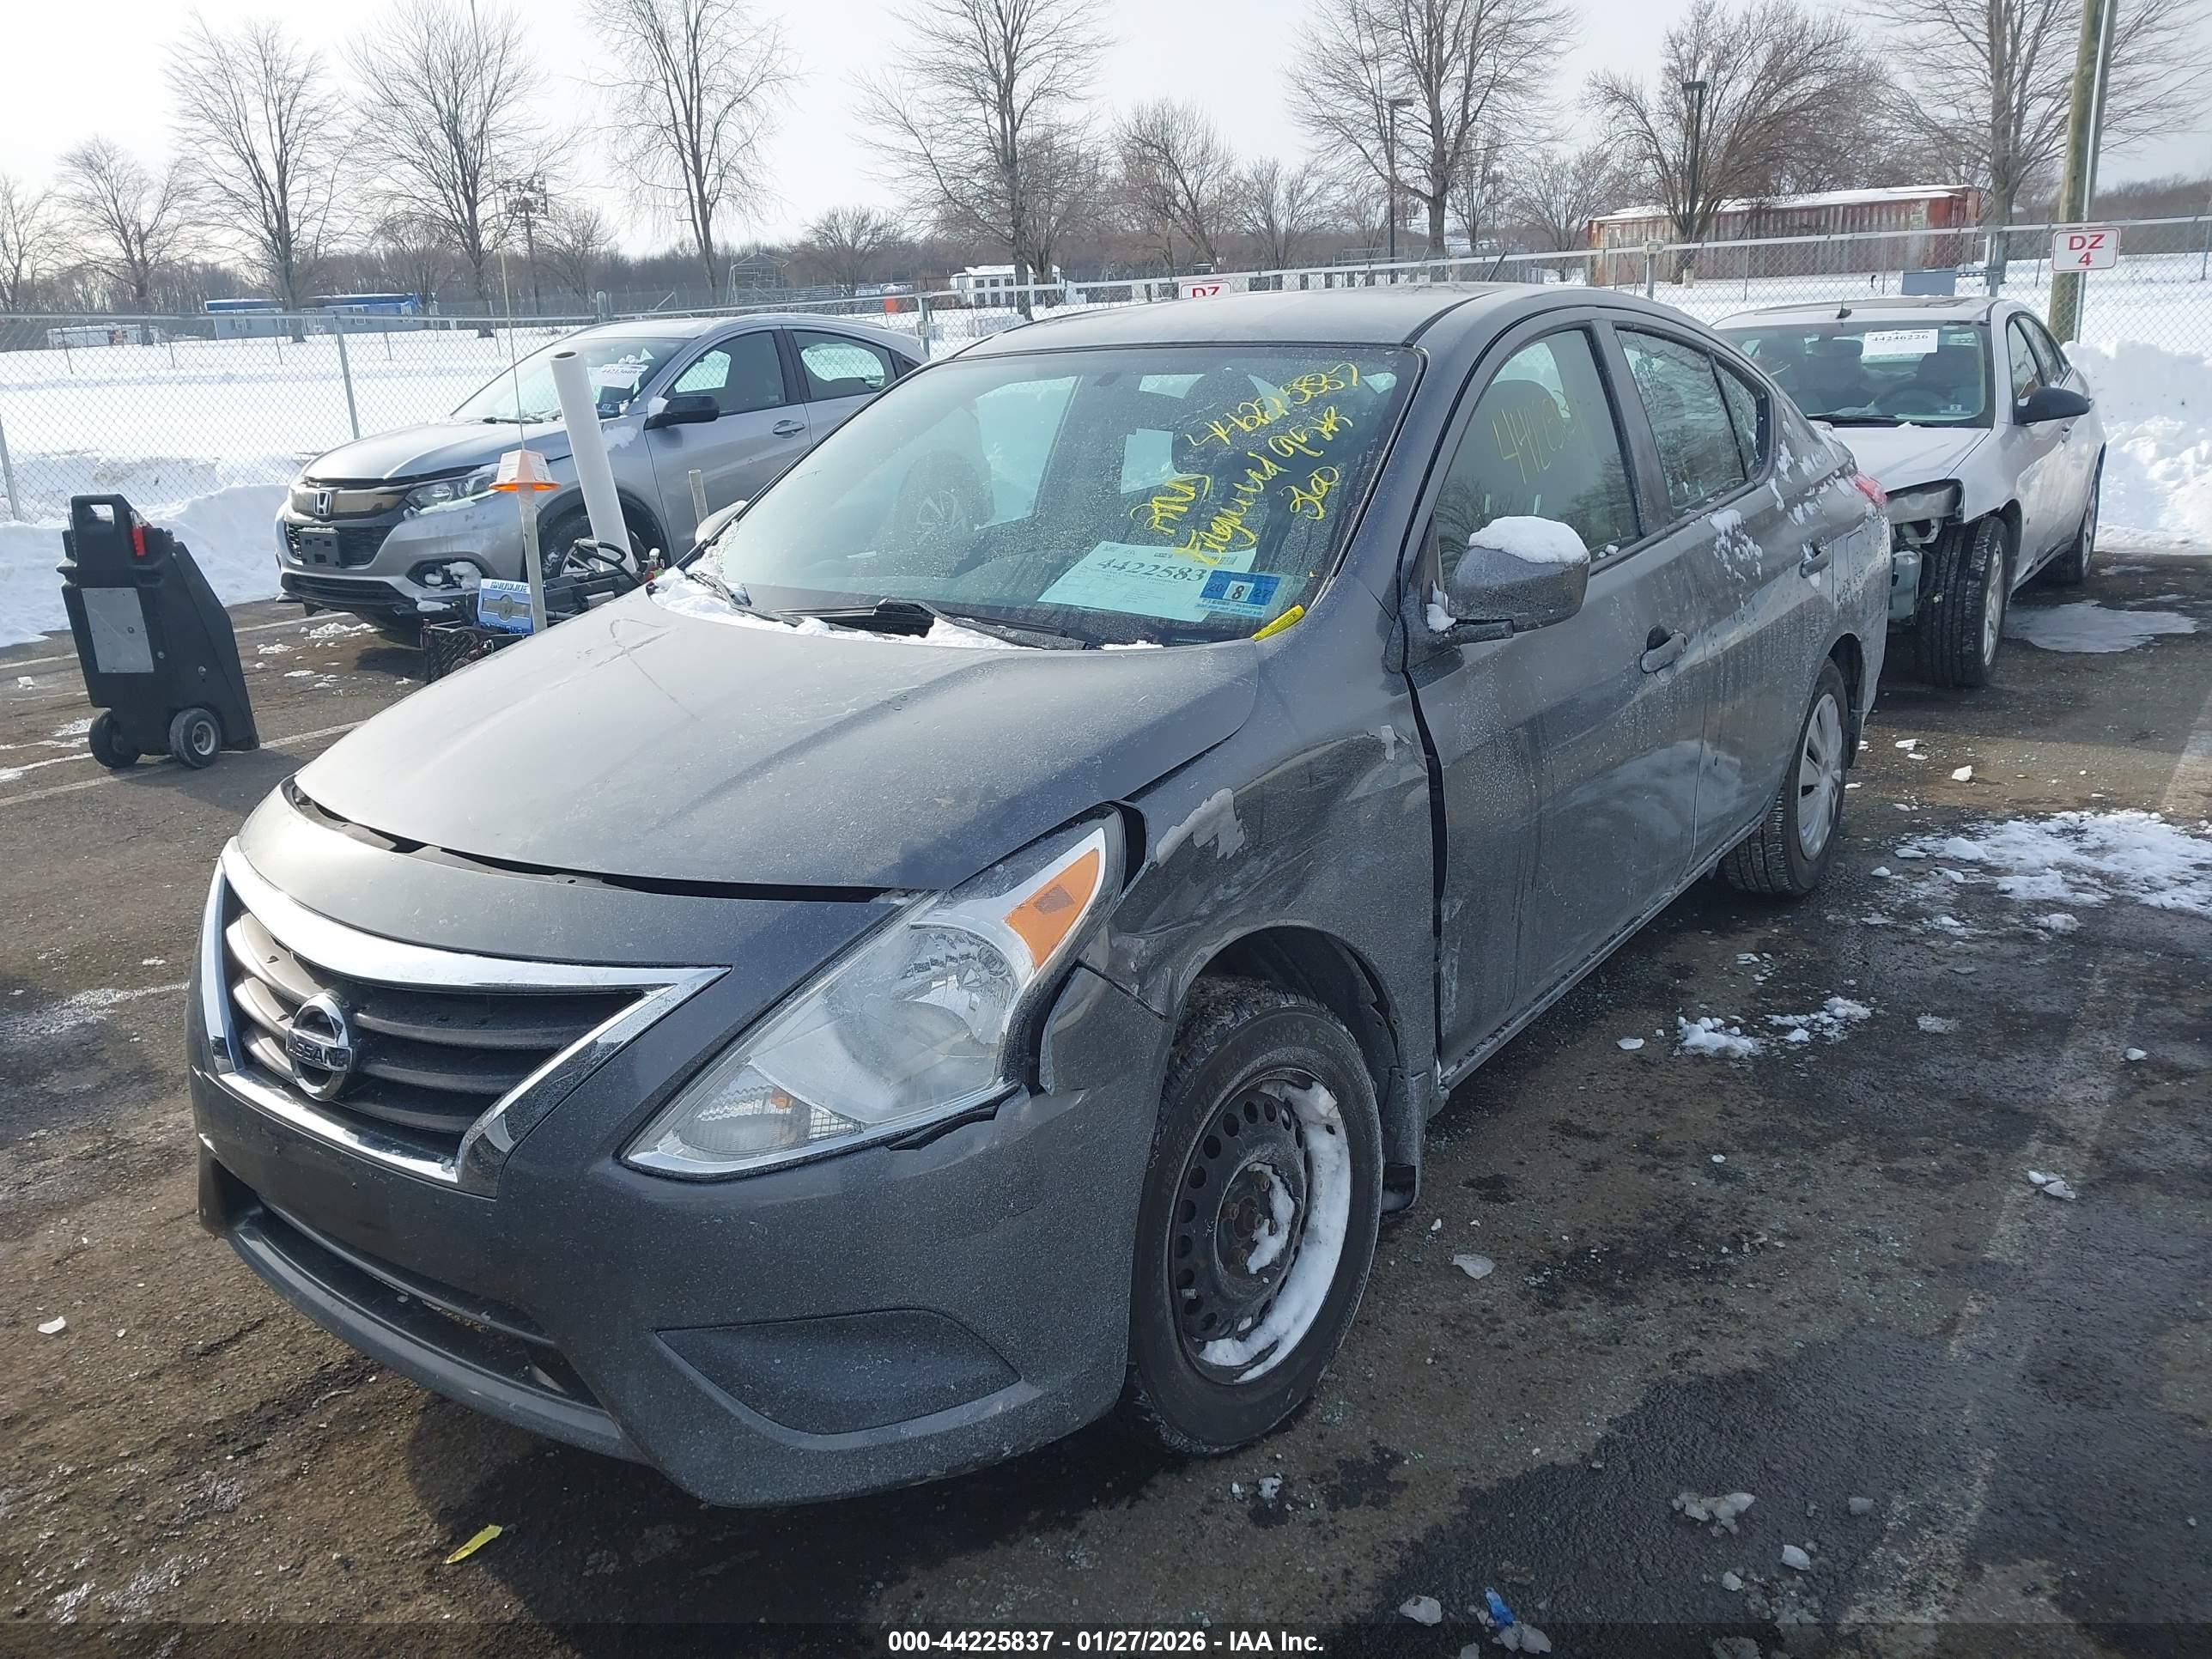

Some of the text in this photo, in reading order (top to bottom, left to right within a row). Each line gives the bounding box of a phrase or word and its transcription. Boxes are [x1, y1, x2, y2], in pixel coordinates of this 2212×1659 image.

[2069, 234, 2106, 250] DZ
[2078, 252, 2093, 265] 4
[1231, 585, 1245, 600] 8
